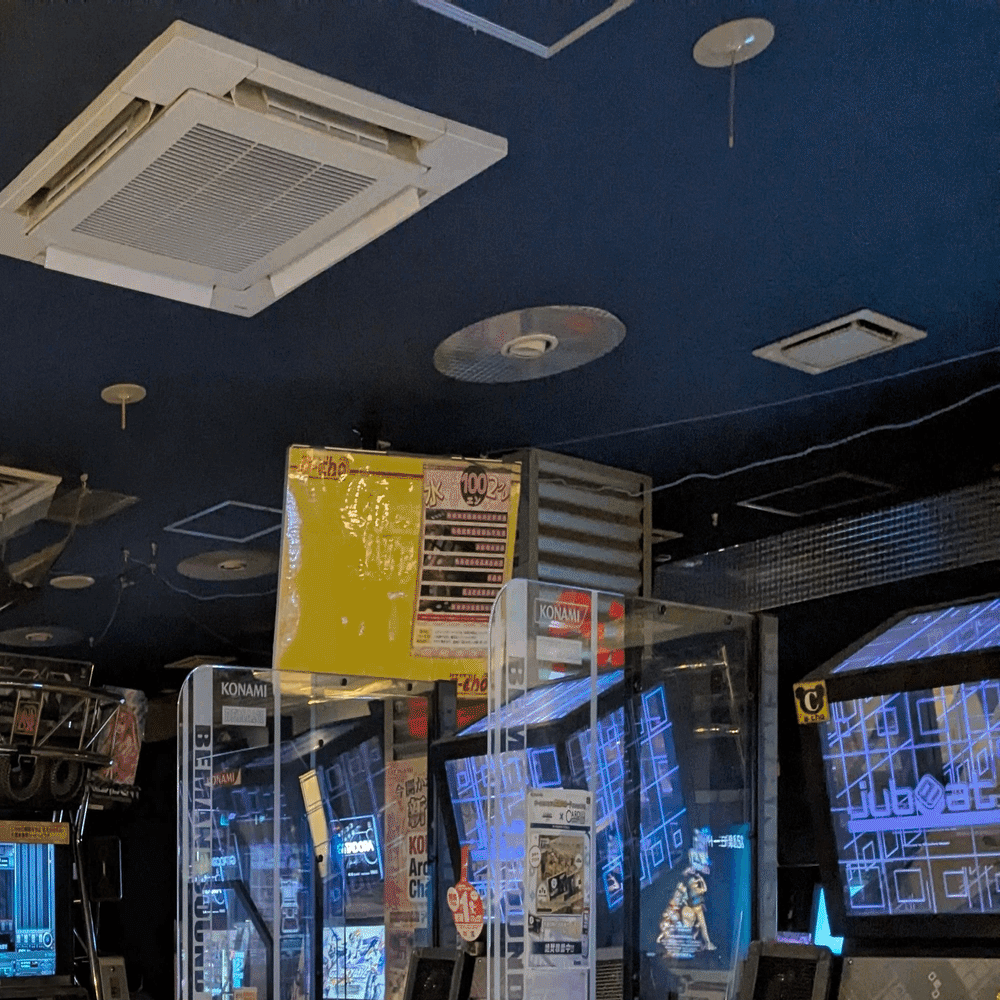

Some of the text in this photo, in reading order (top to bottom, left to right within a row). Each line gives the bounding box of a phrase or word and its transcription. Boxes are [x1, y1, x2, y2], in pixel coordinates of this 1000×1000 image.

[540, 604, 580, 623] KONAMI
[221, 682, 268, 698] KONAMI
[409, 834, 428, 855] KO
